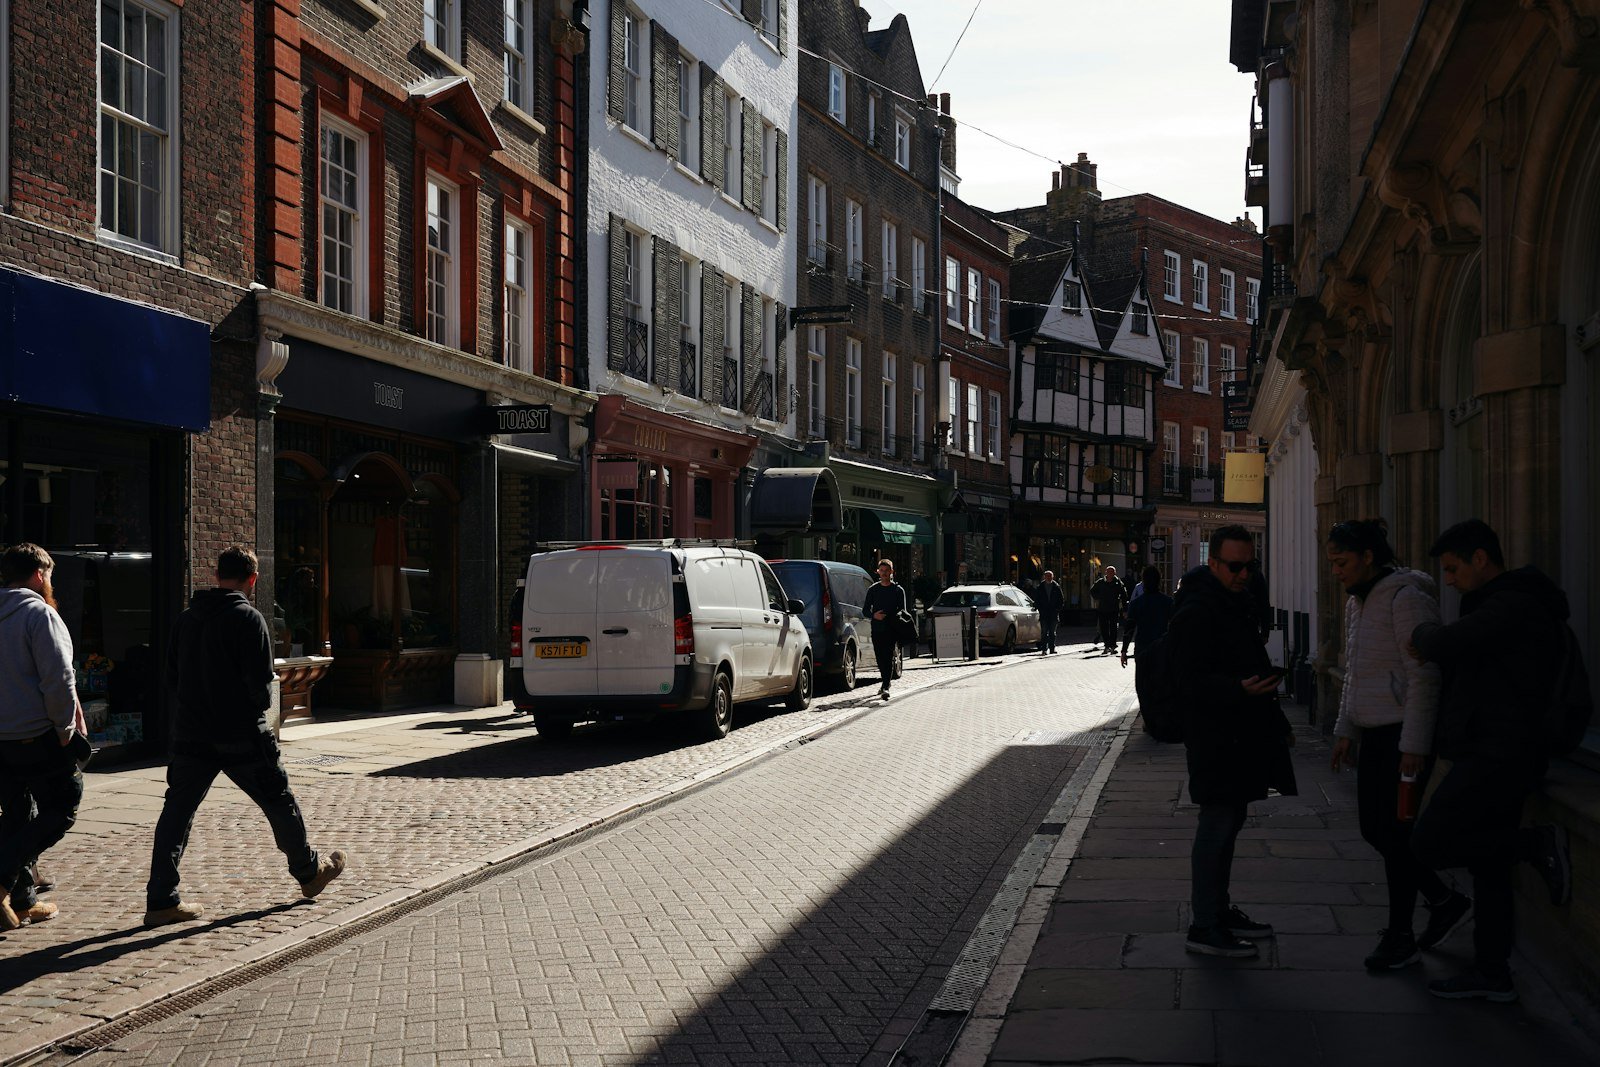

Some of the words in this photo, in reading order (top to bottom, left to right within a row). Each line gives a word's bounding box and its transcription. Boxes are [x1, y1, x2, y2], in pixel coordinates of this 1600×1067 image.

[374, 382, 404, 410] TOAST
[497, 409, 549, 430] TOAST
[634, 424, 667, 452] CUBITTS
[541, 646, 561, 656] KS71
